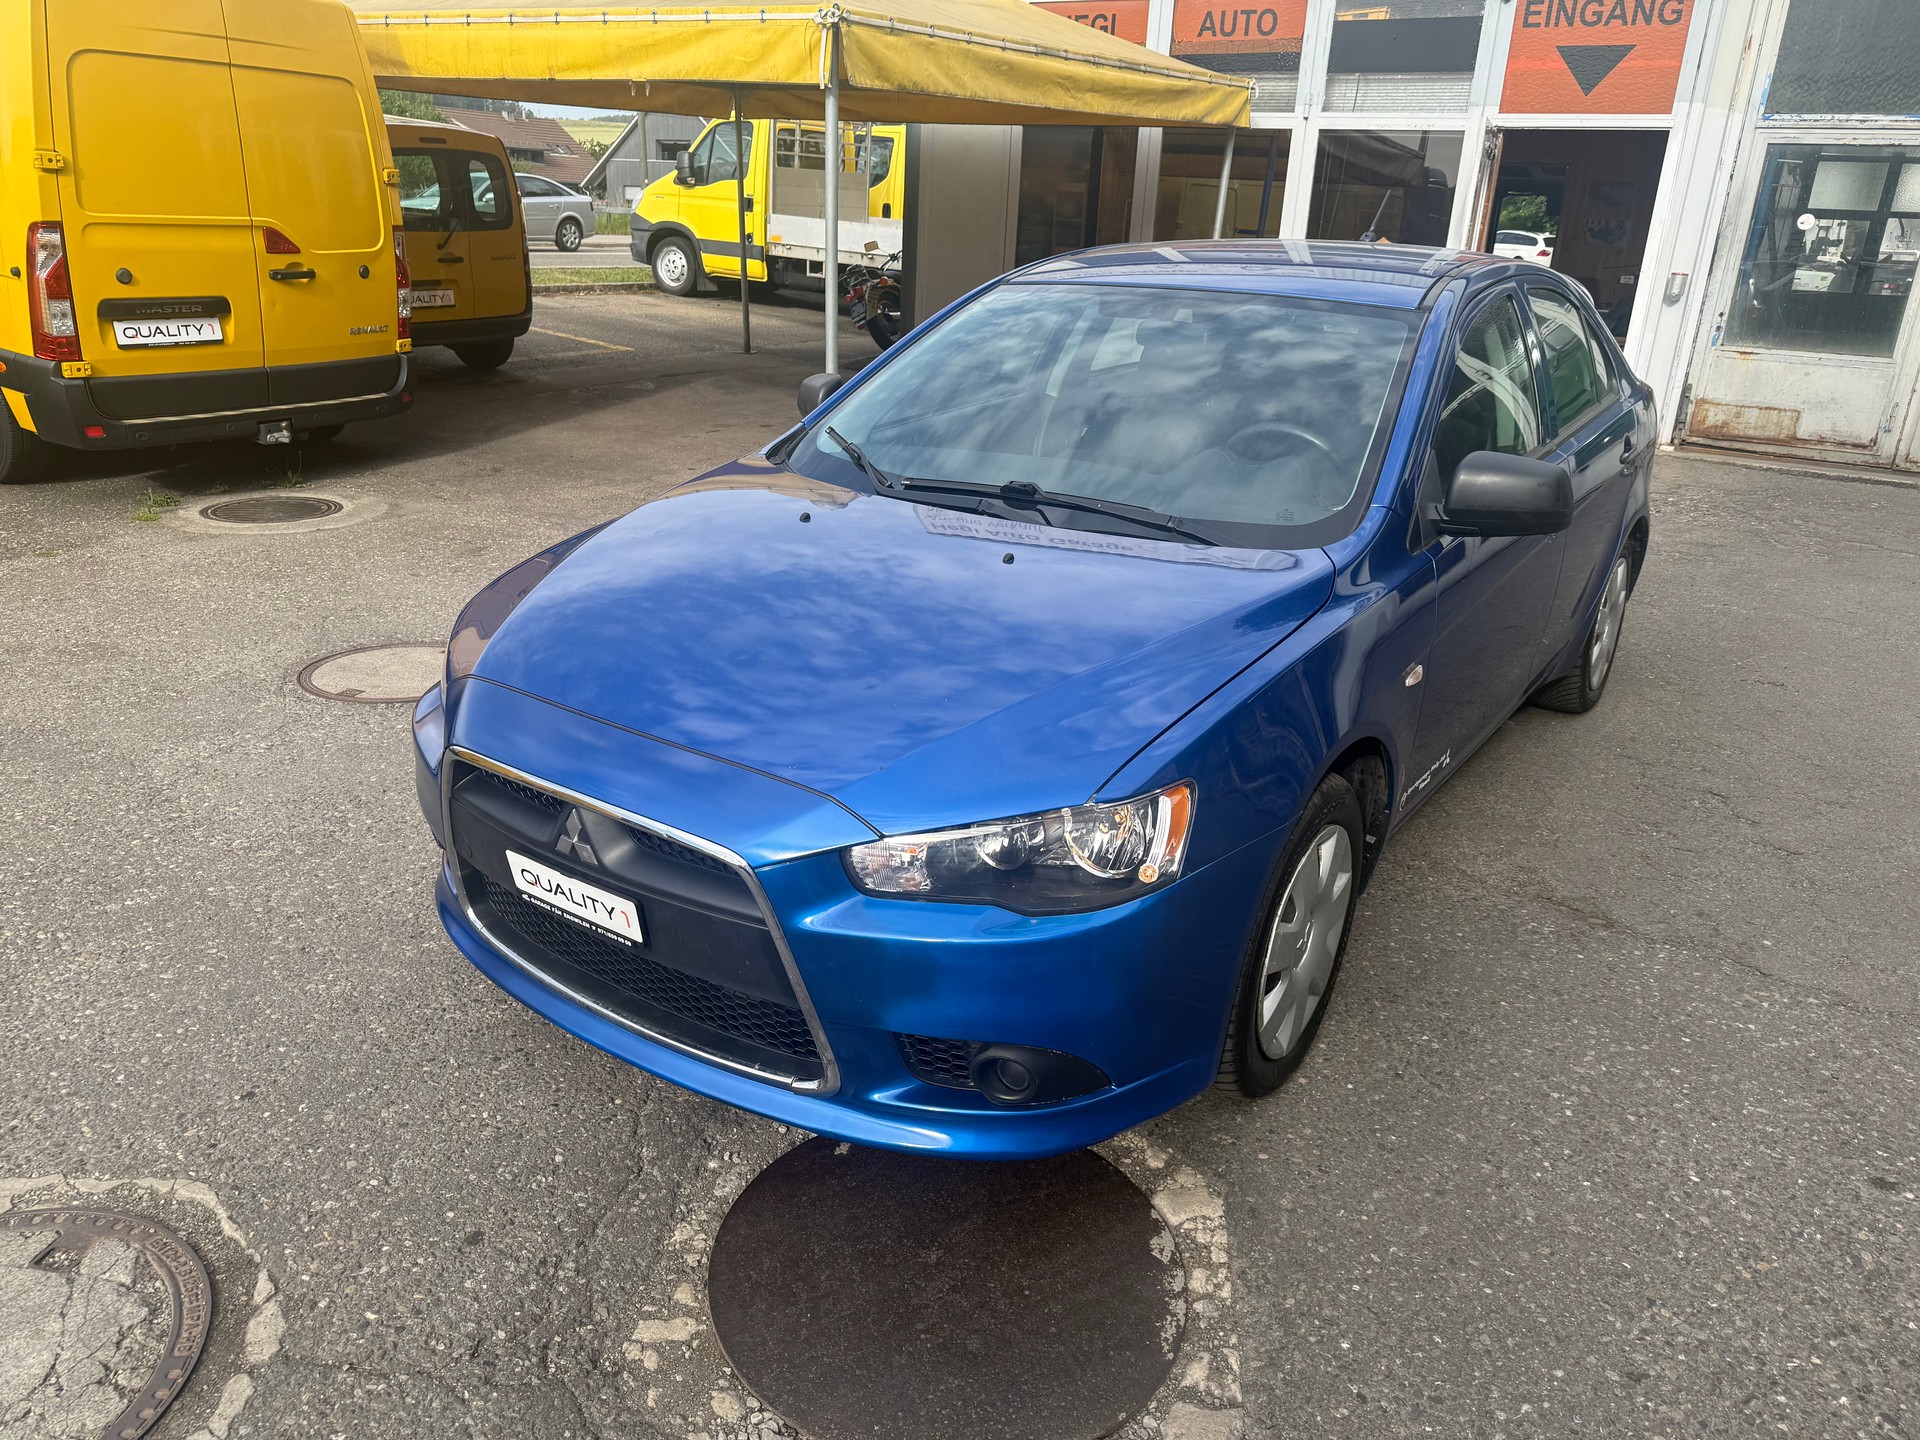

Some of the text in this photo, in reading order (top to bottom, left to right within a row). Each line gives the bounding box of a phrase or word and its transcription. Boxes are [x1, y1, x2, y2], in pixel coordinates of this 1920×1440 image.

[1197, 8, 1278, 37] AUTO
[1522, 0, 1684, 28] EINGANG
[136, 304, 203, 314] MASTER
[123, 323, 204, 339] QUALITY
[349, 325, 388, 335] RENAULT
[520, 868, 616, 921] QUALITY
